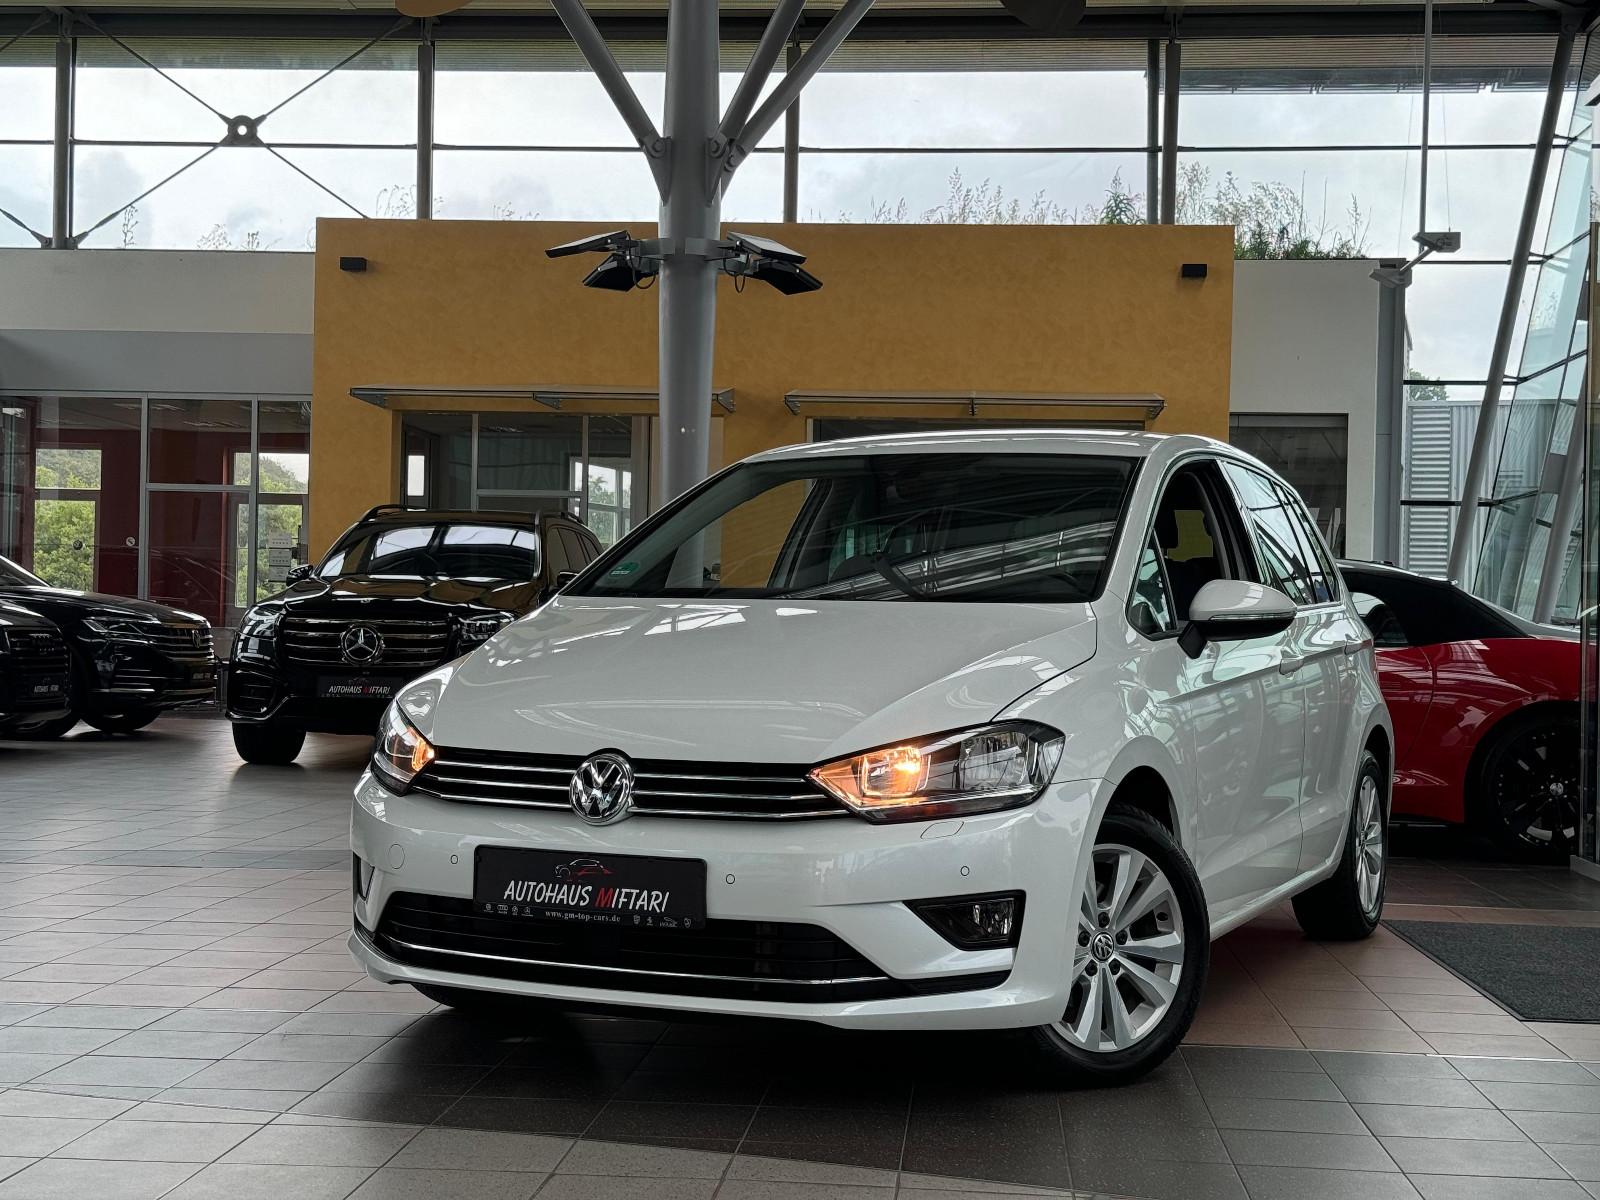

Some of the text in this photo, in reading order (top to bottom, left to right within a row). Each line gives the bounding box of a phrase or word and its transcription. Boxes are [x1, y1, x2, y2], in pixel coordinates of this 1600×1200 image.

[328, 685, 362, 694] AUTOHAUS
[503, 879, 670, 913] AUTOHAUS MIFTARI
[545, 911, 621, 922] www.gm-top-cars.de
